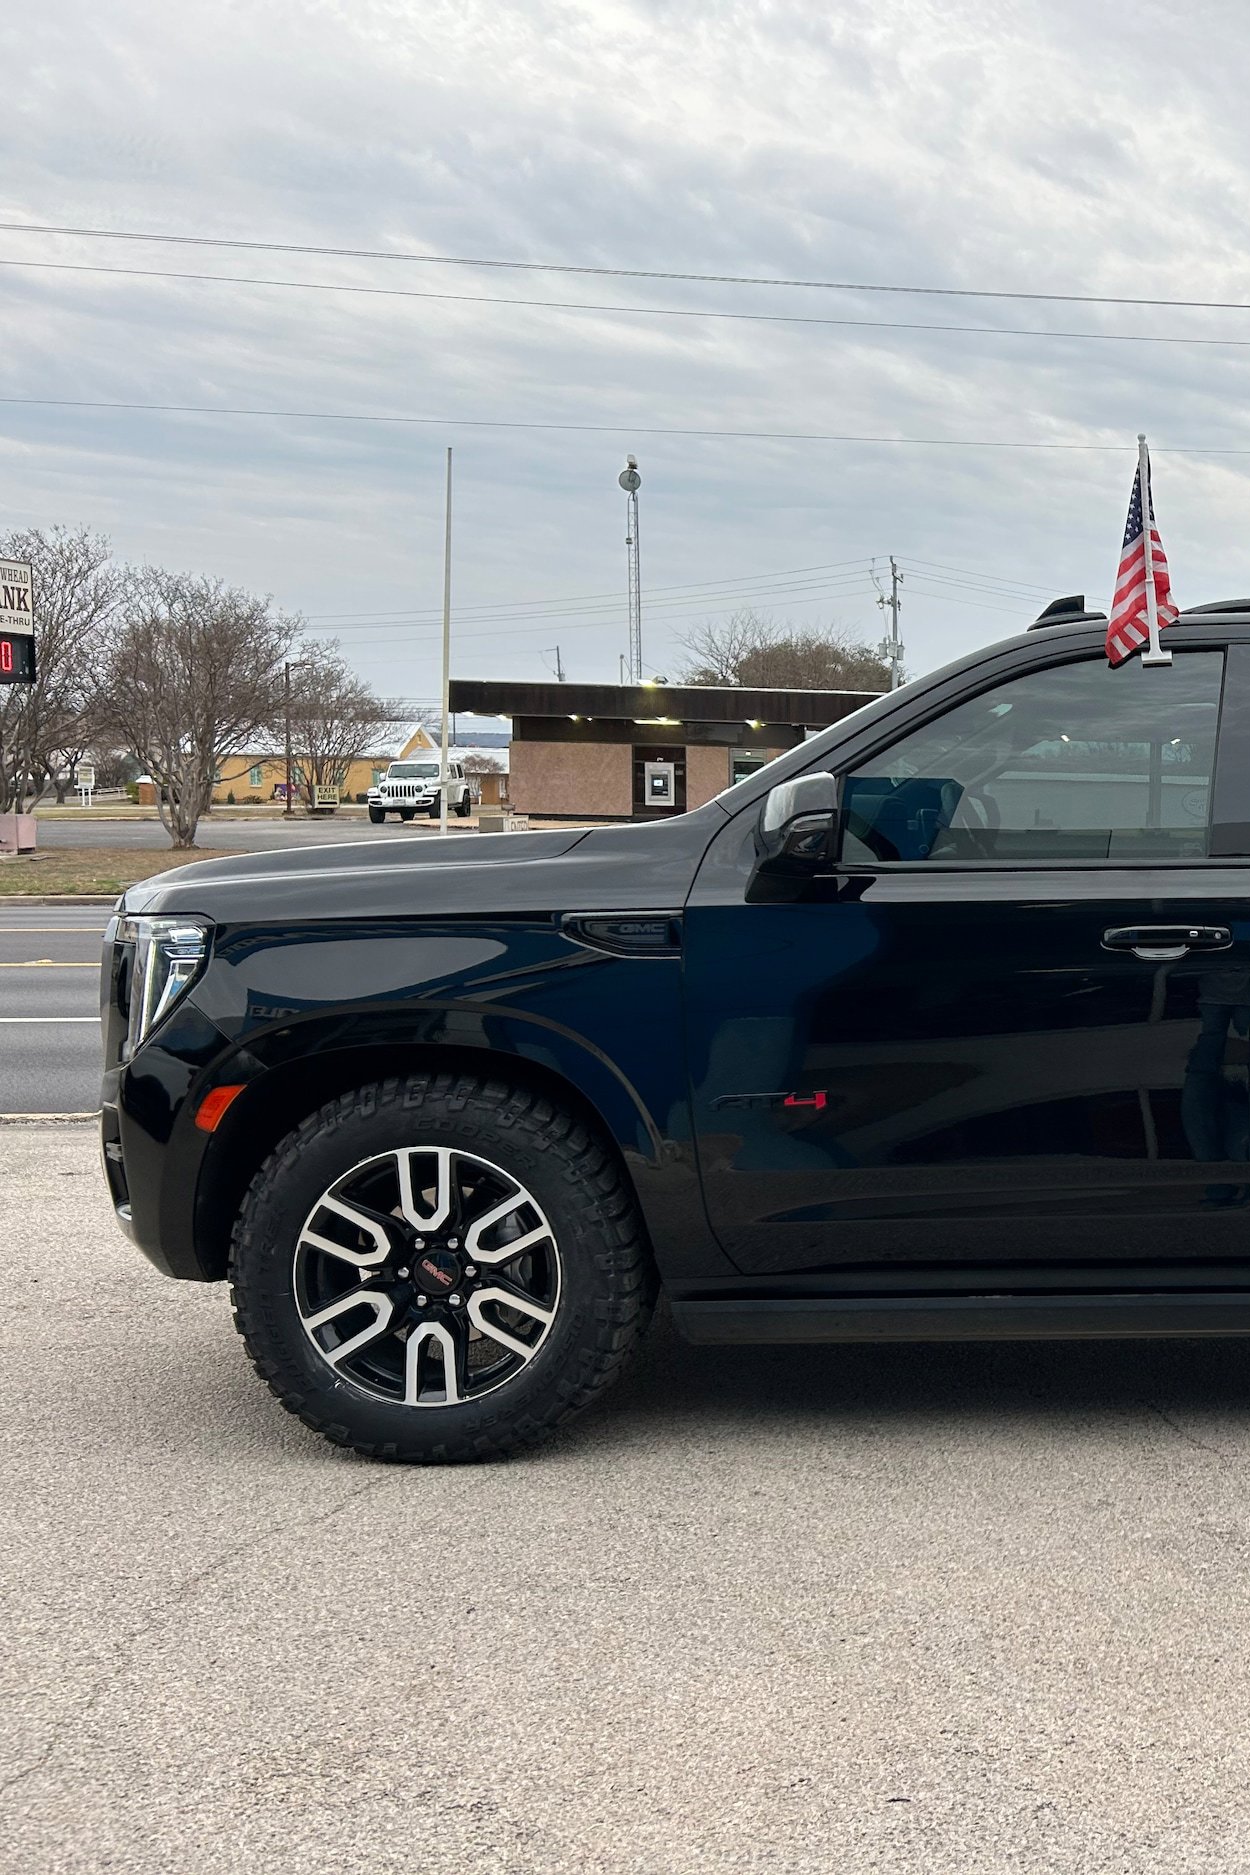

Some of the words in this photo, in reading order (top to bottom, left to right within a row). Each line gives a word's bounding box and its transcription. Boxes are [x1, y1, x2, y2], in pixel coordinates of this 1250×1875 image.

[0, 585, 30, 612] NK
[619, 923, 666, 934] GMC
[414, 1116, 537, 1169] COOPER
[422, 1259, 453, 1286] GMC
